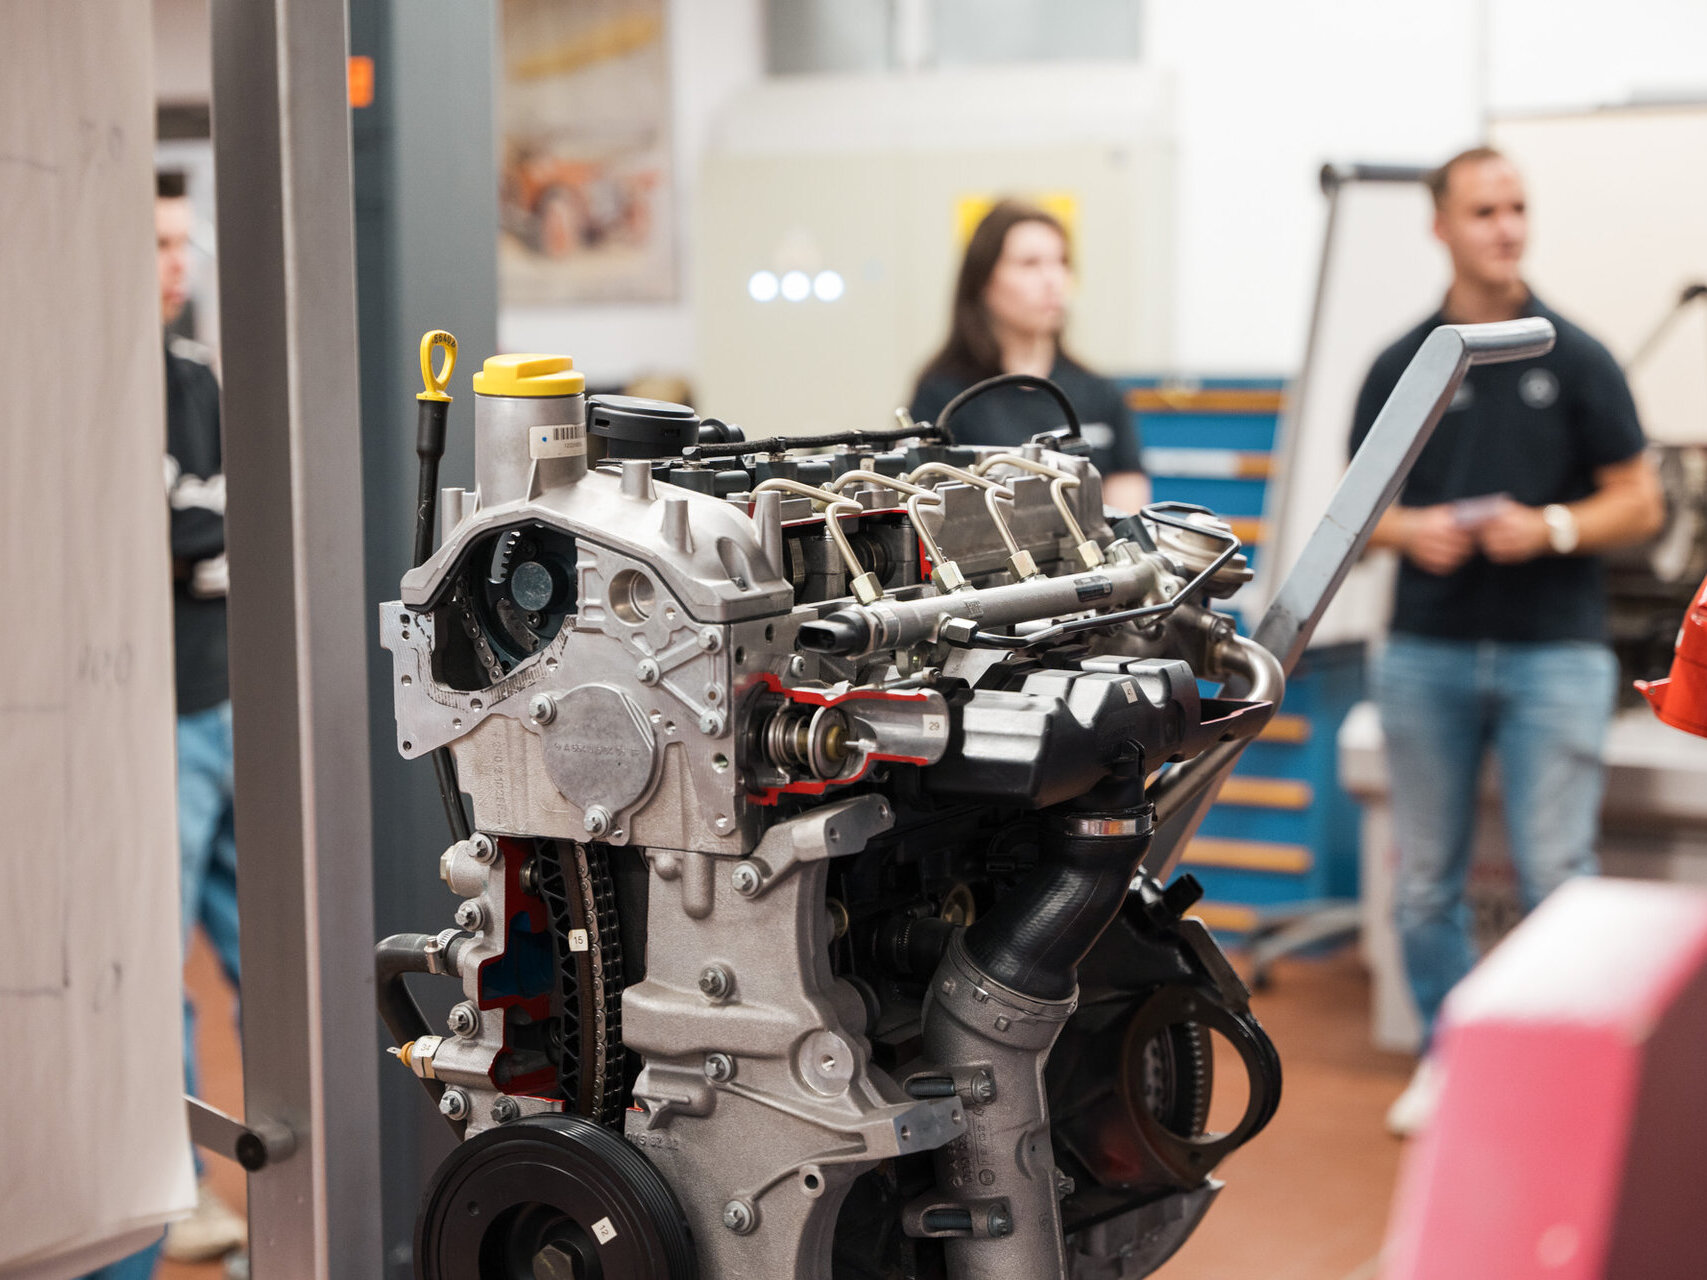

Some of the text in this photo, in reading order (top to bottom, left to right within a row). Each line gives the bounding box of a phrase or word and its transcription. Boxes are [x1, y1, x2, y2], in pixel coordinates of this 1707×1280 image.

[928, 721, 940, 731] 29
[574, 935, 584, 945] 15
[599, 1224, 609, 1236] 12
